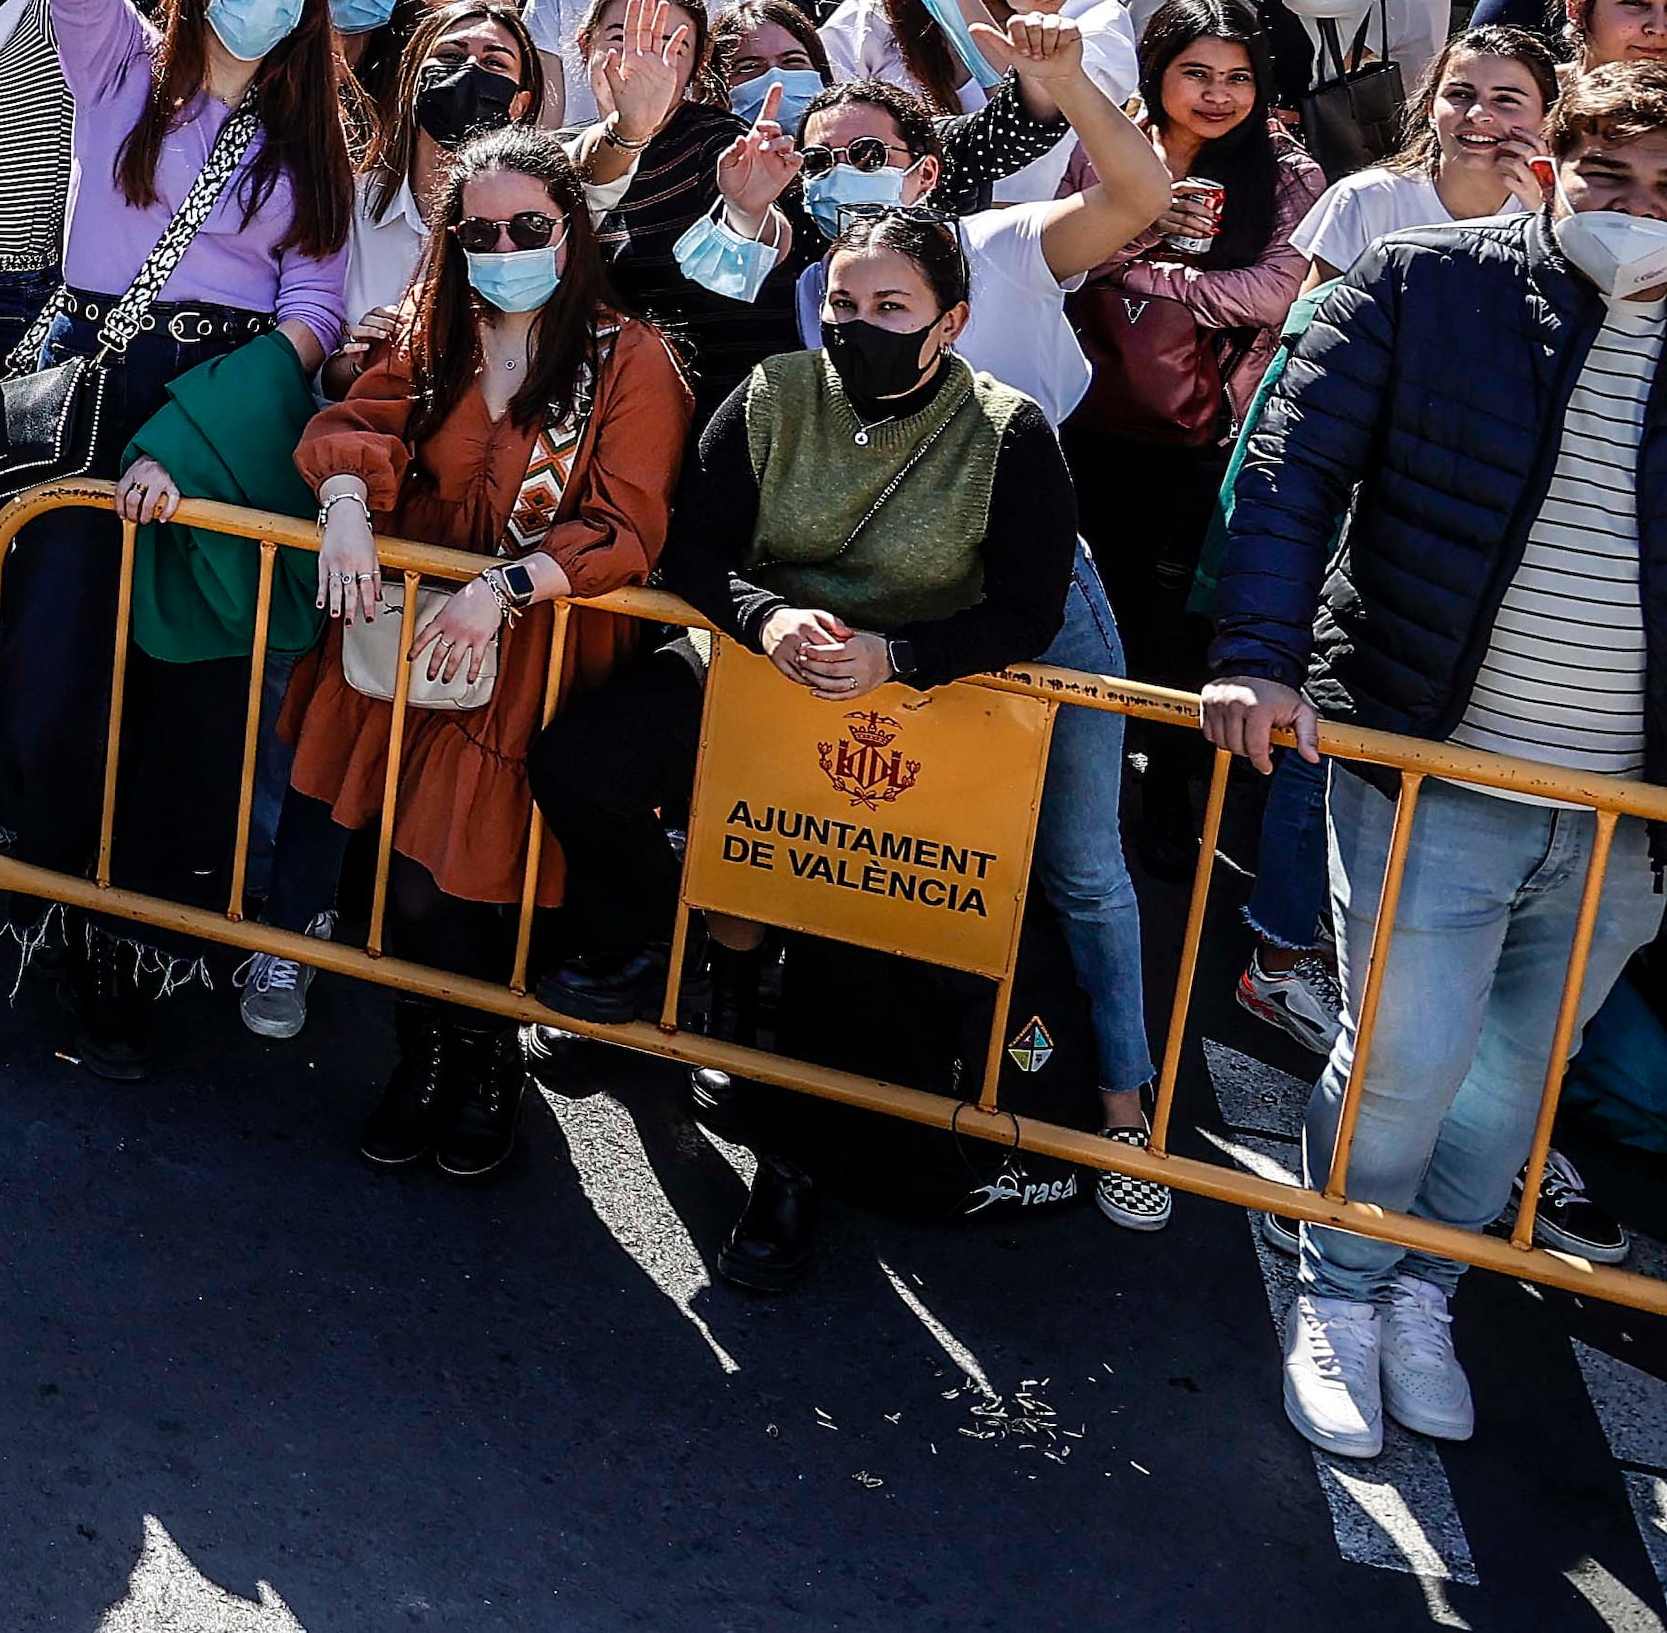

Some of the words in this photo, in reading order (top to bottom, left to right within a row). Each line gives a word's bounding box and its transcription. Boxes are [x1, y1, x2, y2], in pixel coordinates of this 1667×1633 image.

[722, 834, 775, 871] DE
[787, 848, 988, 918] VALÈNCIA
[725, 799, 997, 880] AJUNTAMENT
